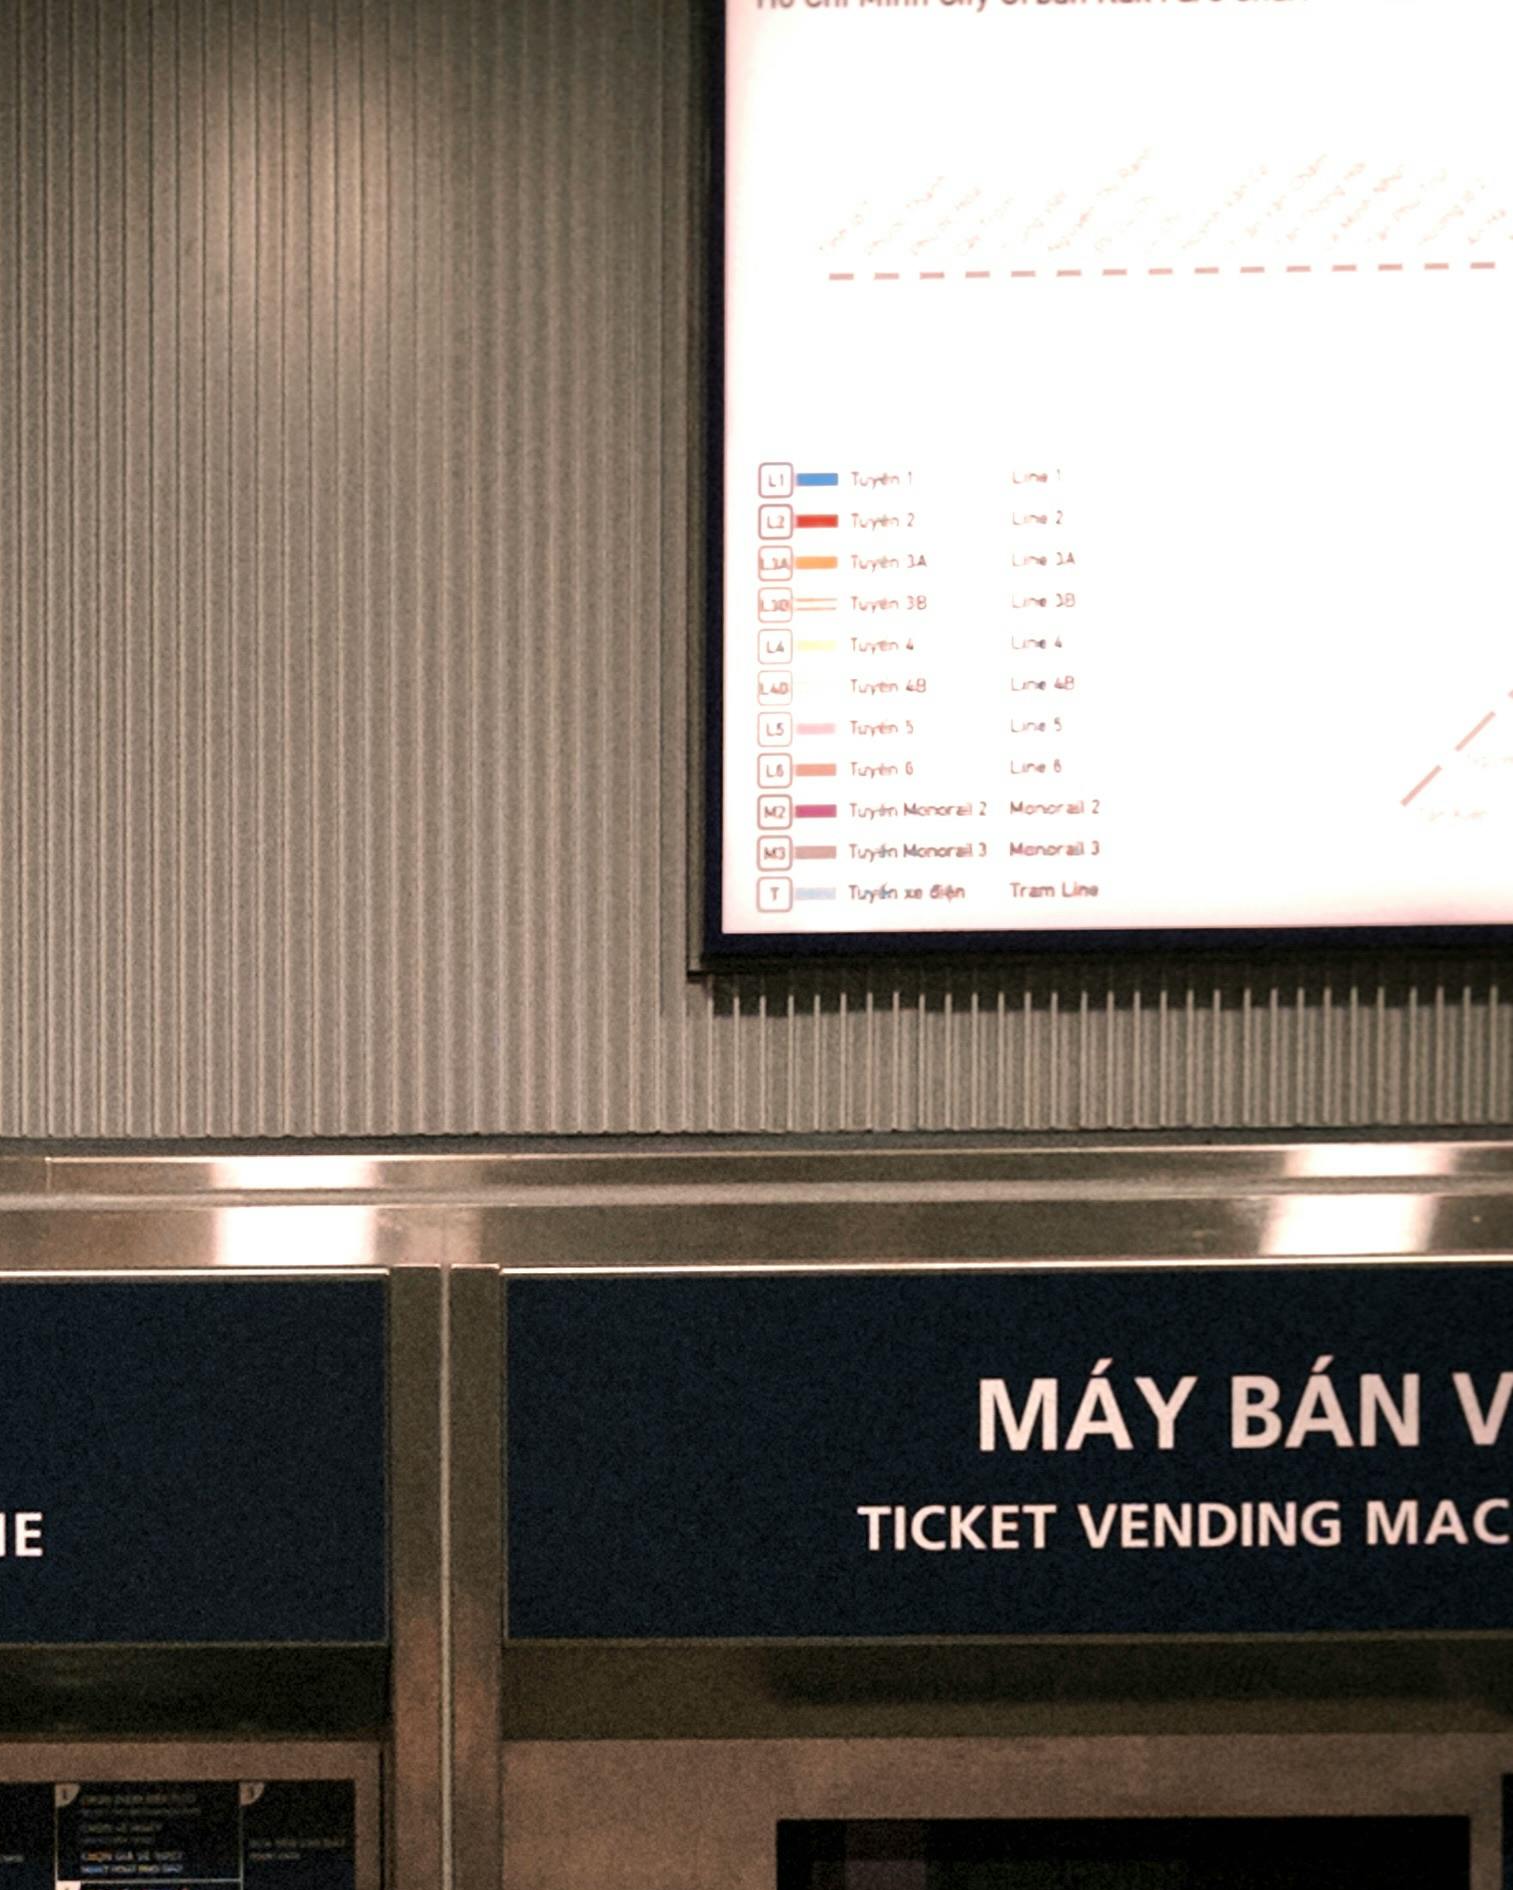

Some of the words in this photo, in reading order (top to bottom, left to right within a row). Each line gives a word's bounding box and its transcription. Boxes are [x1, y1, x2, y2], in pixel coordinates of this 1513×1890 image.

[1012, 472, 1048, 485] Line
[1012, 512, 1048, 526] Line
[1012, 555, 1048, 567] Line
[1012, 597, 1048, 608] Line
[1012, 637, 1047, 650] Line
[1011, 678, 1047, 691] Line
[1010, 720, 1046, 733] Line
[1010, 760, 1047, 775] Line
[903, 802, 972, 817] Monorail
[1010, 800, 1085, 815] Monorail
[903, 843, 973, 858] Monorail
[1009, 841, 1085, 856] Monorail
[1010, 882, 1056, 898] Tram
[1061, 881, 1099, 898] Line
[980, 1358, 1197, 1451] MÁY
[1232, 1355, 1419, 1448] BÁN
[857, 1505, 1057, 1550] TICKET
[1078, 1501, 1340, 1548] VENDING
